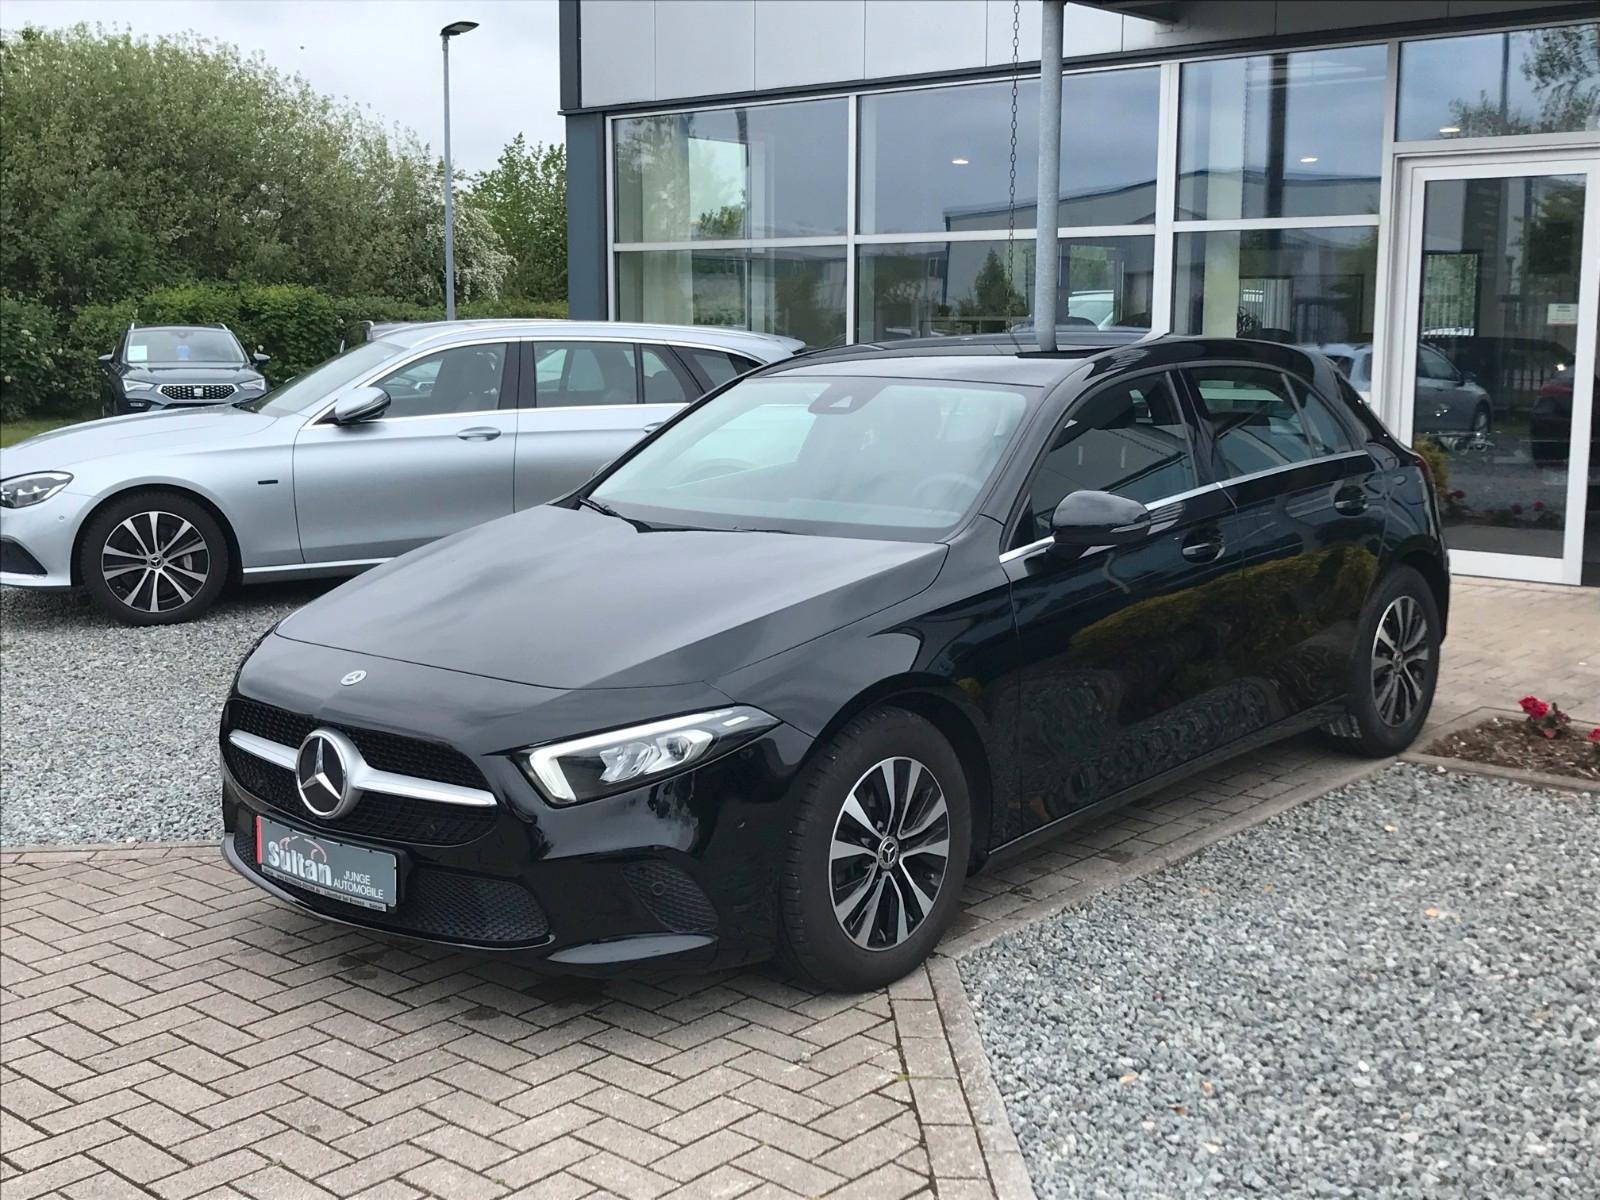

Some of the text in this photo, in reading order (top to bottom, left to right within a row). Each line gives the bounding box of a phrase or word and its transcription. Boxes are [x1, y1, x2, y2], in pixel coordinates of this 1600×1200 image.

[268, 841, 332, 886] Sultan
[333, 878, 384, 900] AUTOMOBILE
[343, 870, 371, 886] JUNGE
